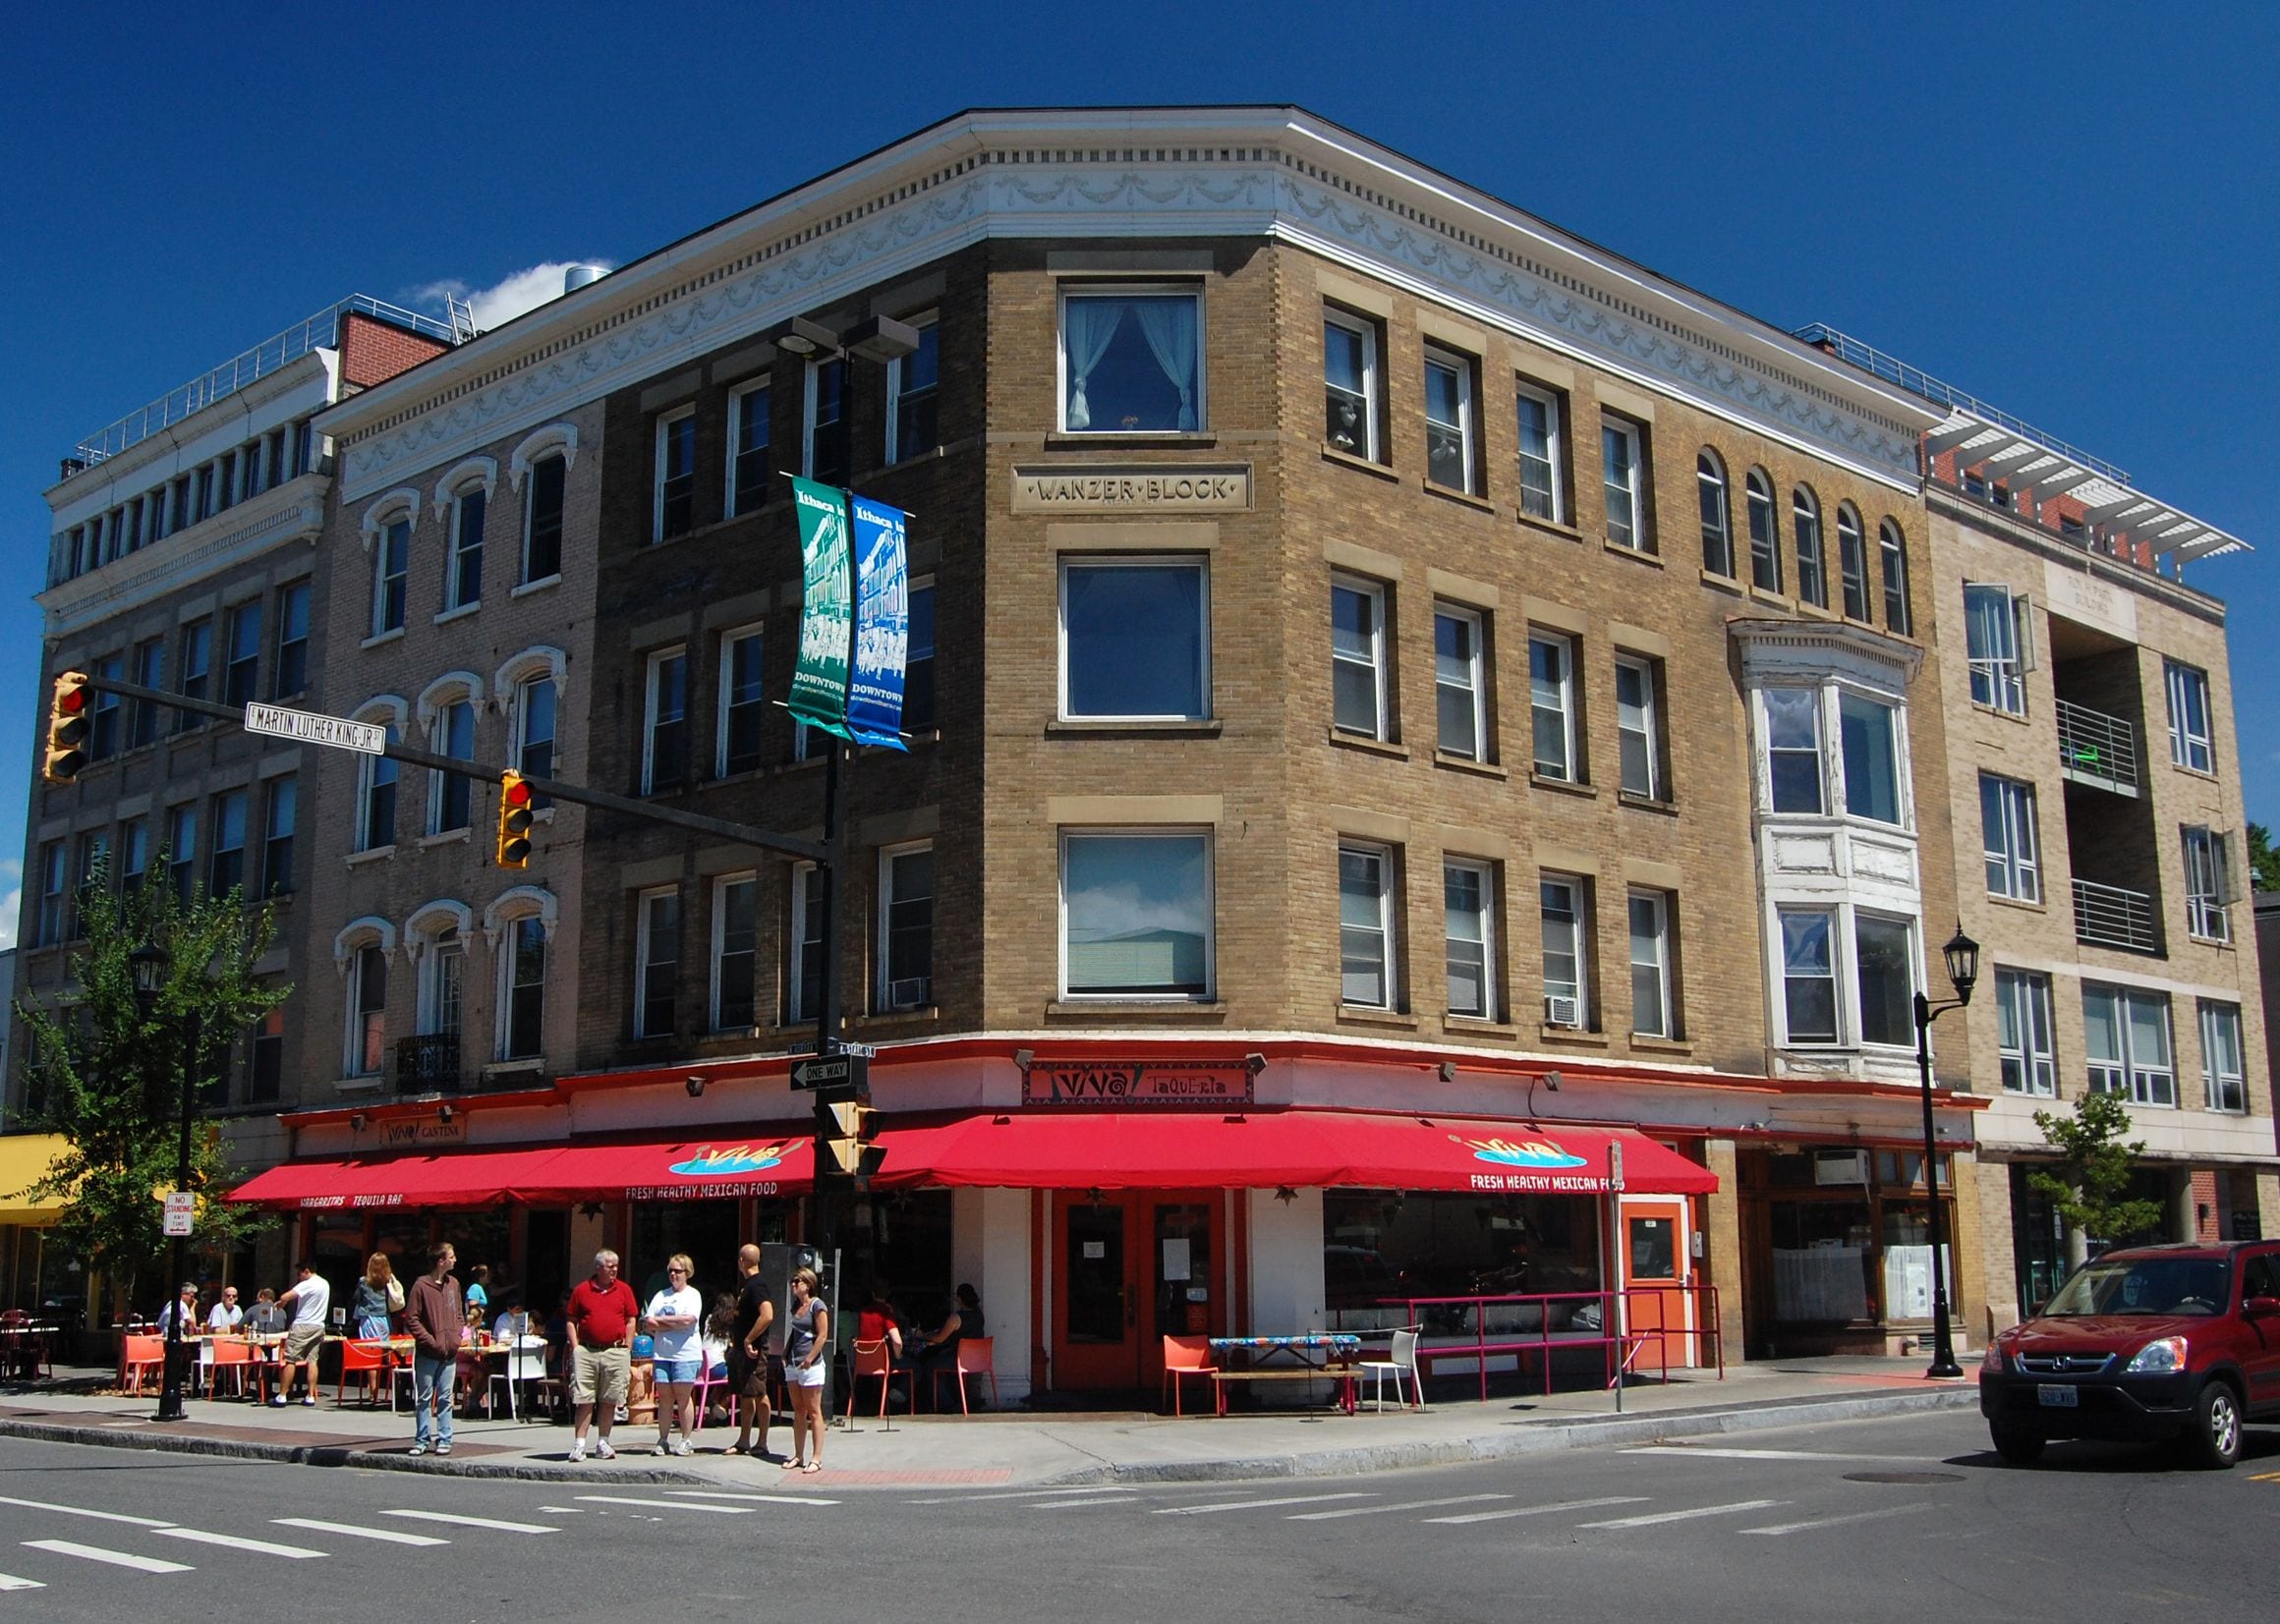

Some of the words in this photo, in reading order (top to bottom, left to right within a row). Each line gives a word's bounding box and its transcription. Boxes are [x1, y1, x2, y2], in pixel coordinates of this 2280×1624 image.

[1037, 477, 1134, 501] WANZER
[1146, 477, 1227, 500] BLOCK
[797, 489, 834, 513] Ithaca
[837, 504, 845, 517] is
[855, 505, 892, 529] Ithaca
[895, 521, 905, 533] is
[794, 671, 846, 694] DOWNTOWN
[851, 683, 903, 703] DOWNTOWN
[256, 707, 295, 734] MARTIN
[296, 715, 334, 741] LUTHER
[806, 1067, 824, 1080] ONE
[826, 1063, 845, 1078] WAY
[625, 1187, 655, 1200] FRESH
[656, 1185, 698, 1199] HEALTHY
[700, 1183, 747, 1198] MEXICAN
[750, 1182, 777, 1196] FOOD
[1470, 1174, 1505, 1190] FRESH
[1506, 1175, 1550, 1191] HEALTHY
[1552, 1177, 1598, 1192] MEXICAN
[167, 1204, 193, 1213] STANDING
[175, 1196, 186, 1204] NO
[354, 1194, 385, 1207] TEQUILA
